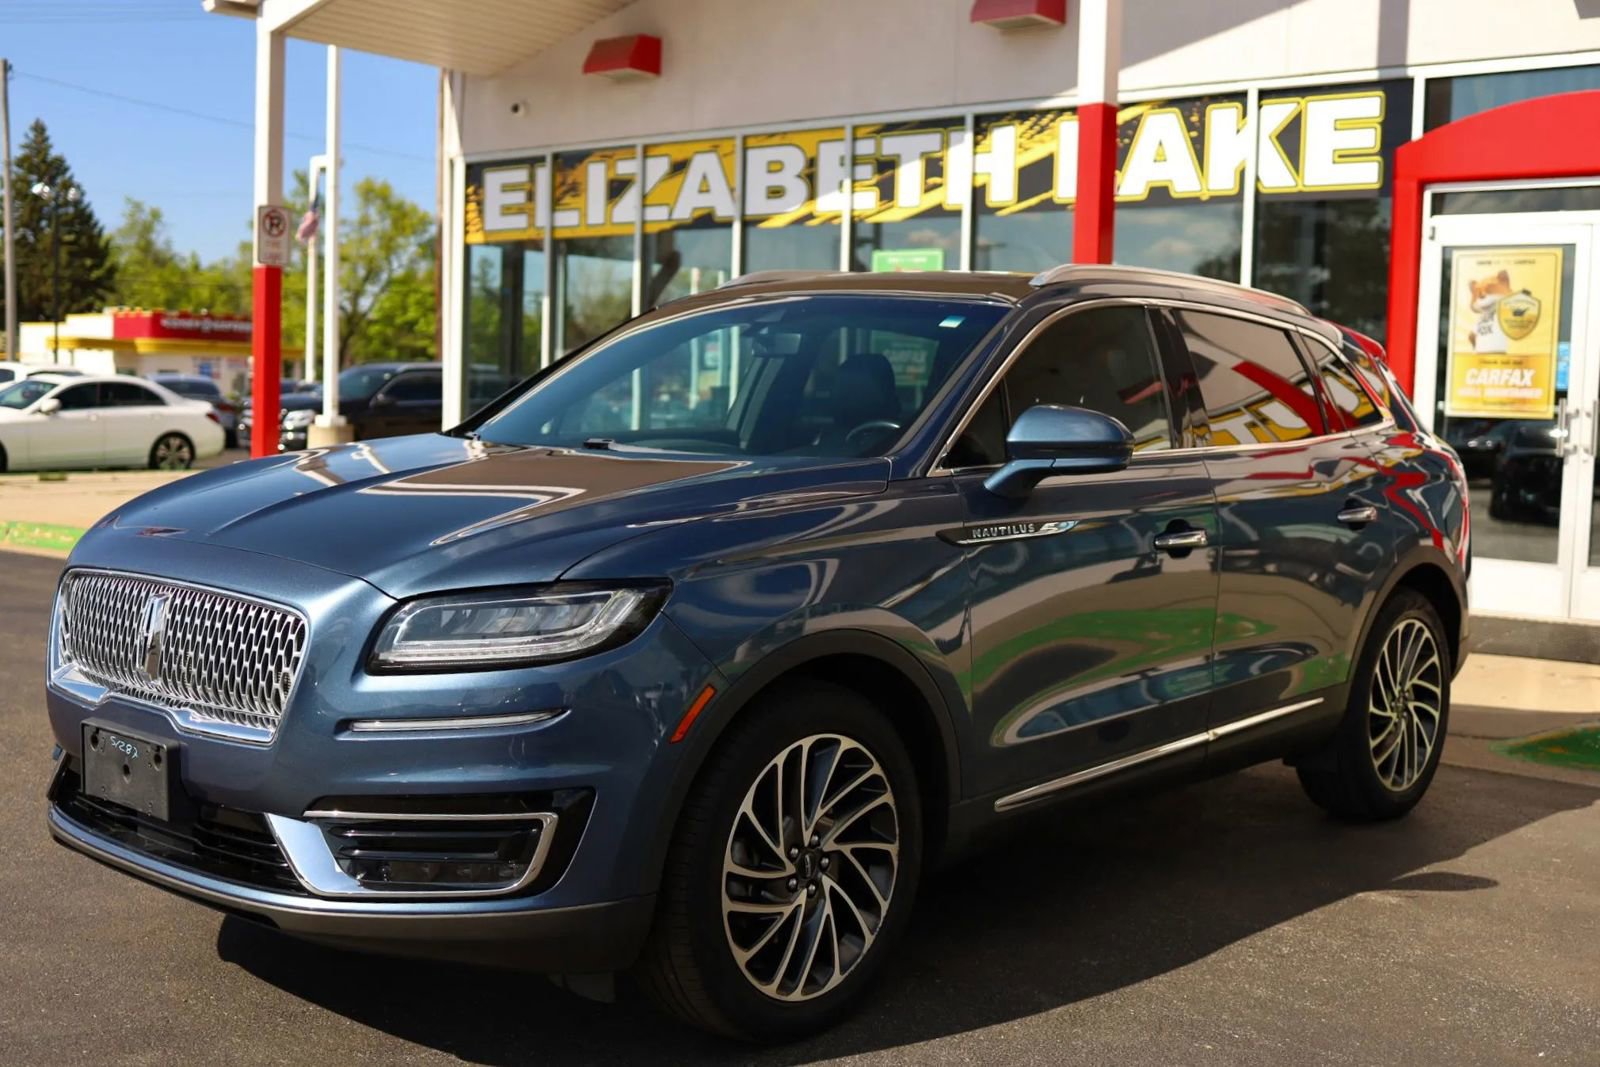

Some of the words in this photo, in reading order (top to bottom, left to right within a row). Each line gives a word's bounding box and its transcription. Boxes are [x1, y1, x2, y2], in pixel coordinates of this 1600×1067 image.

[482, 123, 1019, 231] ELIZABETH
[1465, 367, 1536, 387] CARFAX
[972, 523, 1035, 538] NAUTILUS
